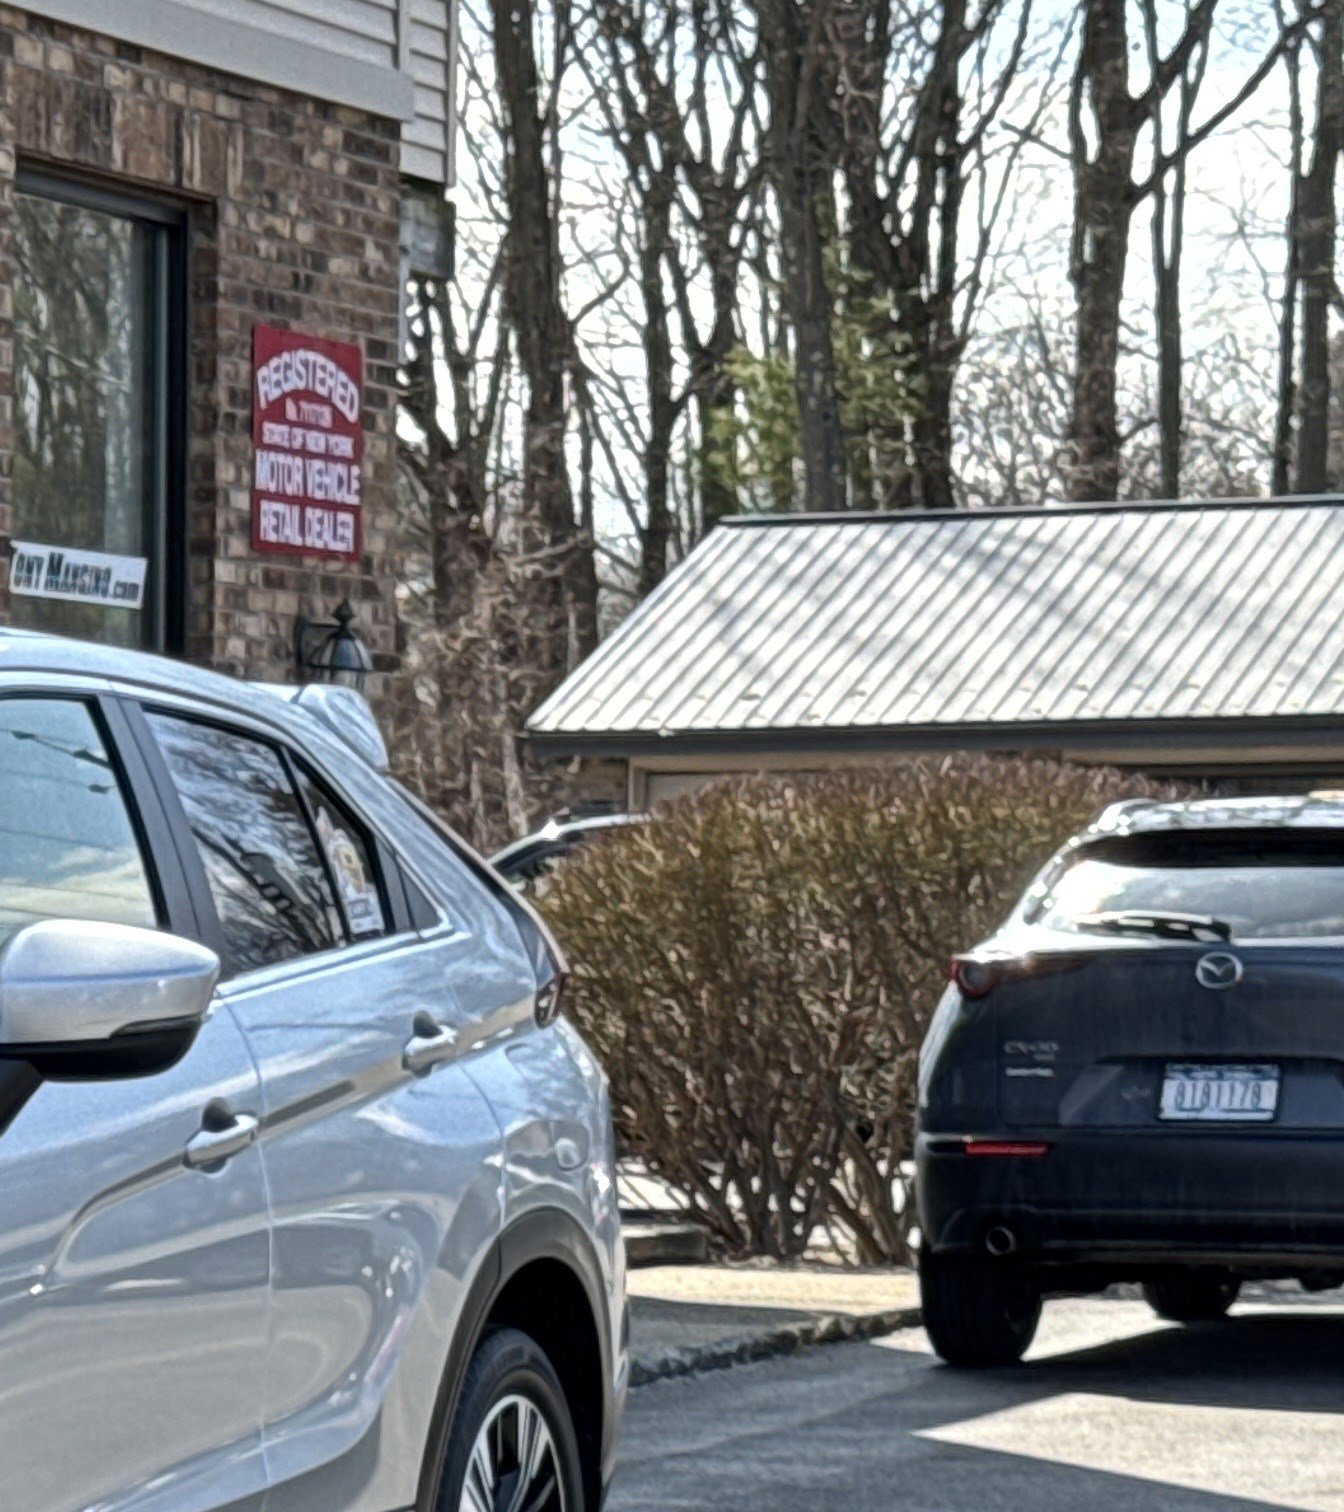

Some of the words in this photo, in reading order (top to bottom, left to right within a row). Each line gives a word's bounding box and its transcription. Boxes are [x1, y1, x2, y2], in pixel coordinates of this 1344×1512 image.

[256, 348, 359, 424] REGISTERED
[255, 449, 304, 497] MOTOR
[305, 458, 361, 505] VEHICLE
[259, 499, 302, 546] RETAIL
[304, 506, 354, 553] DEALER
